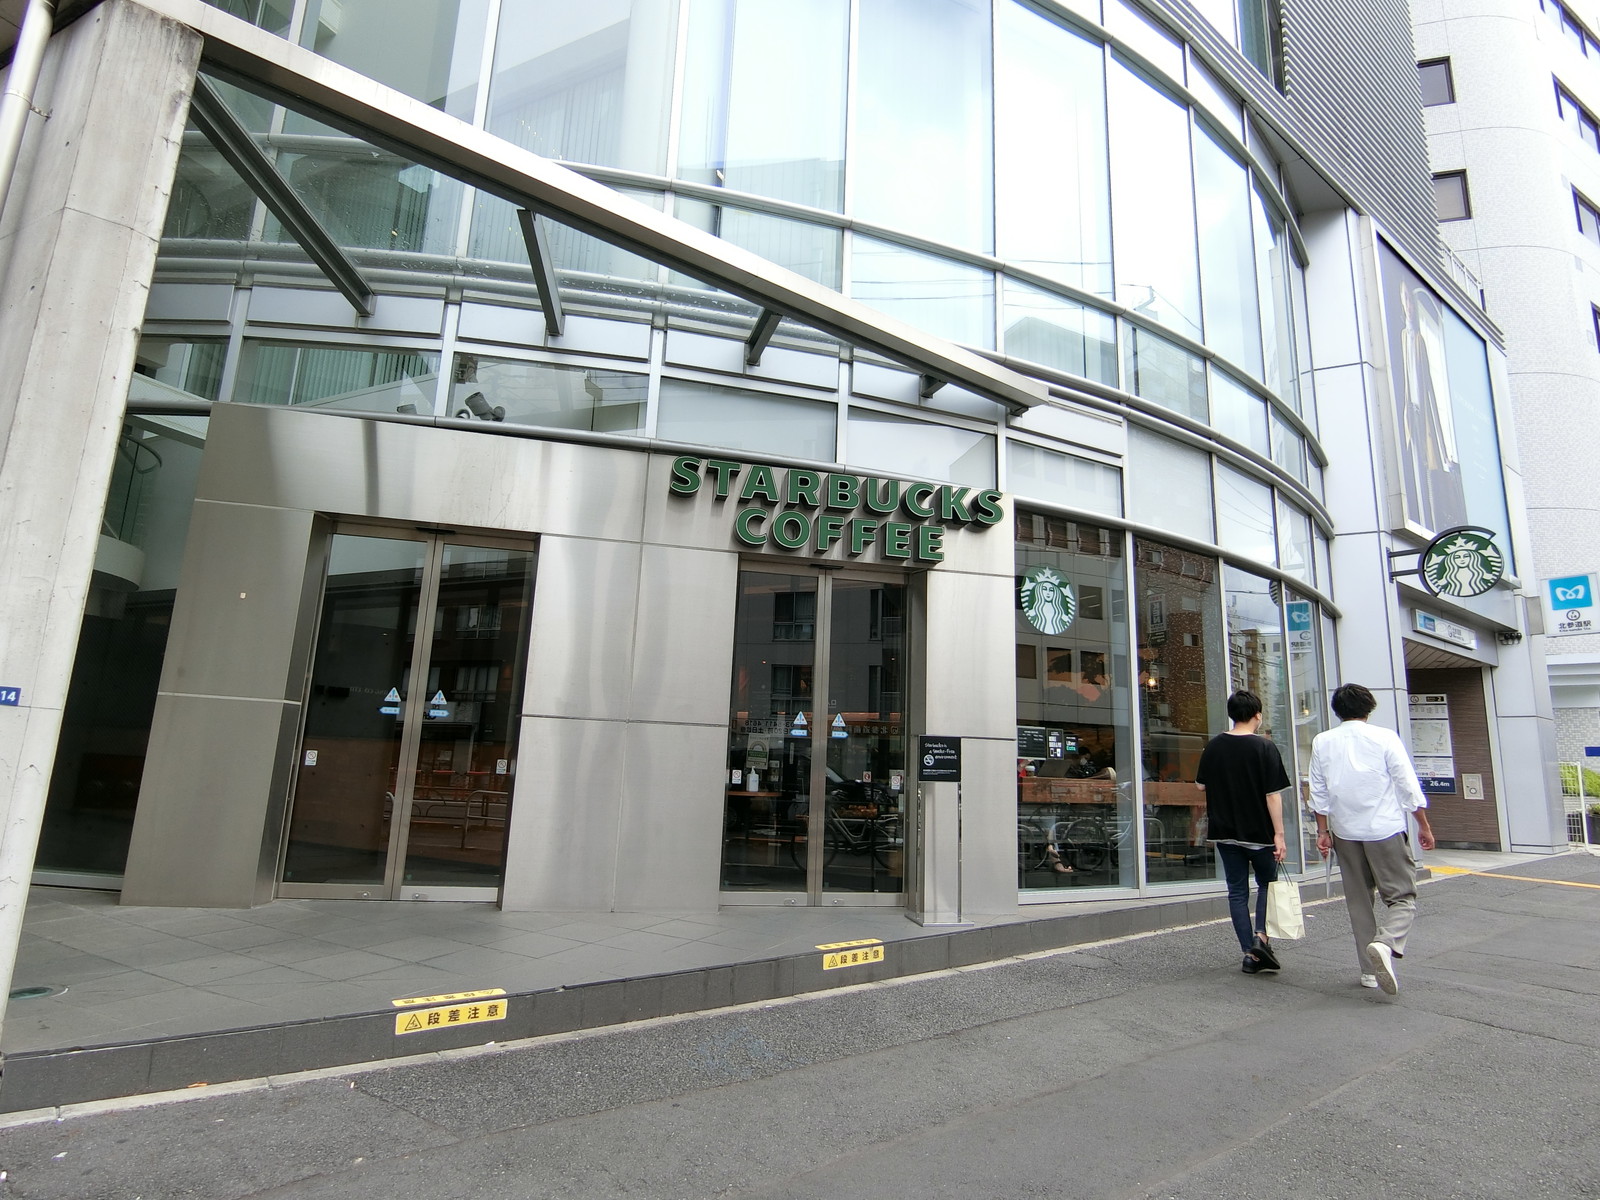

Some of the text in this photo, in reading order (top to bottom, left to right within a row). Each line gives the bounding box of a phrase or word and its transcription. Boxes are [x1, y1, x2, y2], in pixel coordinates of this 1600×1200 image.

[670, 456, 1005, 527] STARBUCKS
[734, 507, 945, 563] COFFEE
[1558, 620, 1592, 629] 北参道駅
[1, 690, 16, 702] 14
[840, 949, 880, 964] 段差注意
[427, 1004, 499, 1026] 段差注意
